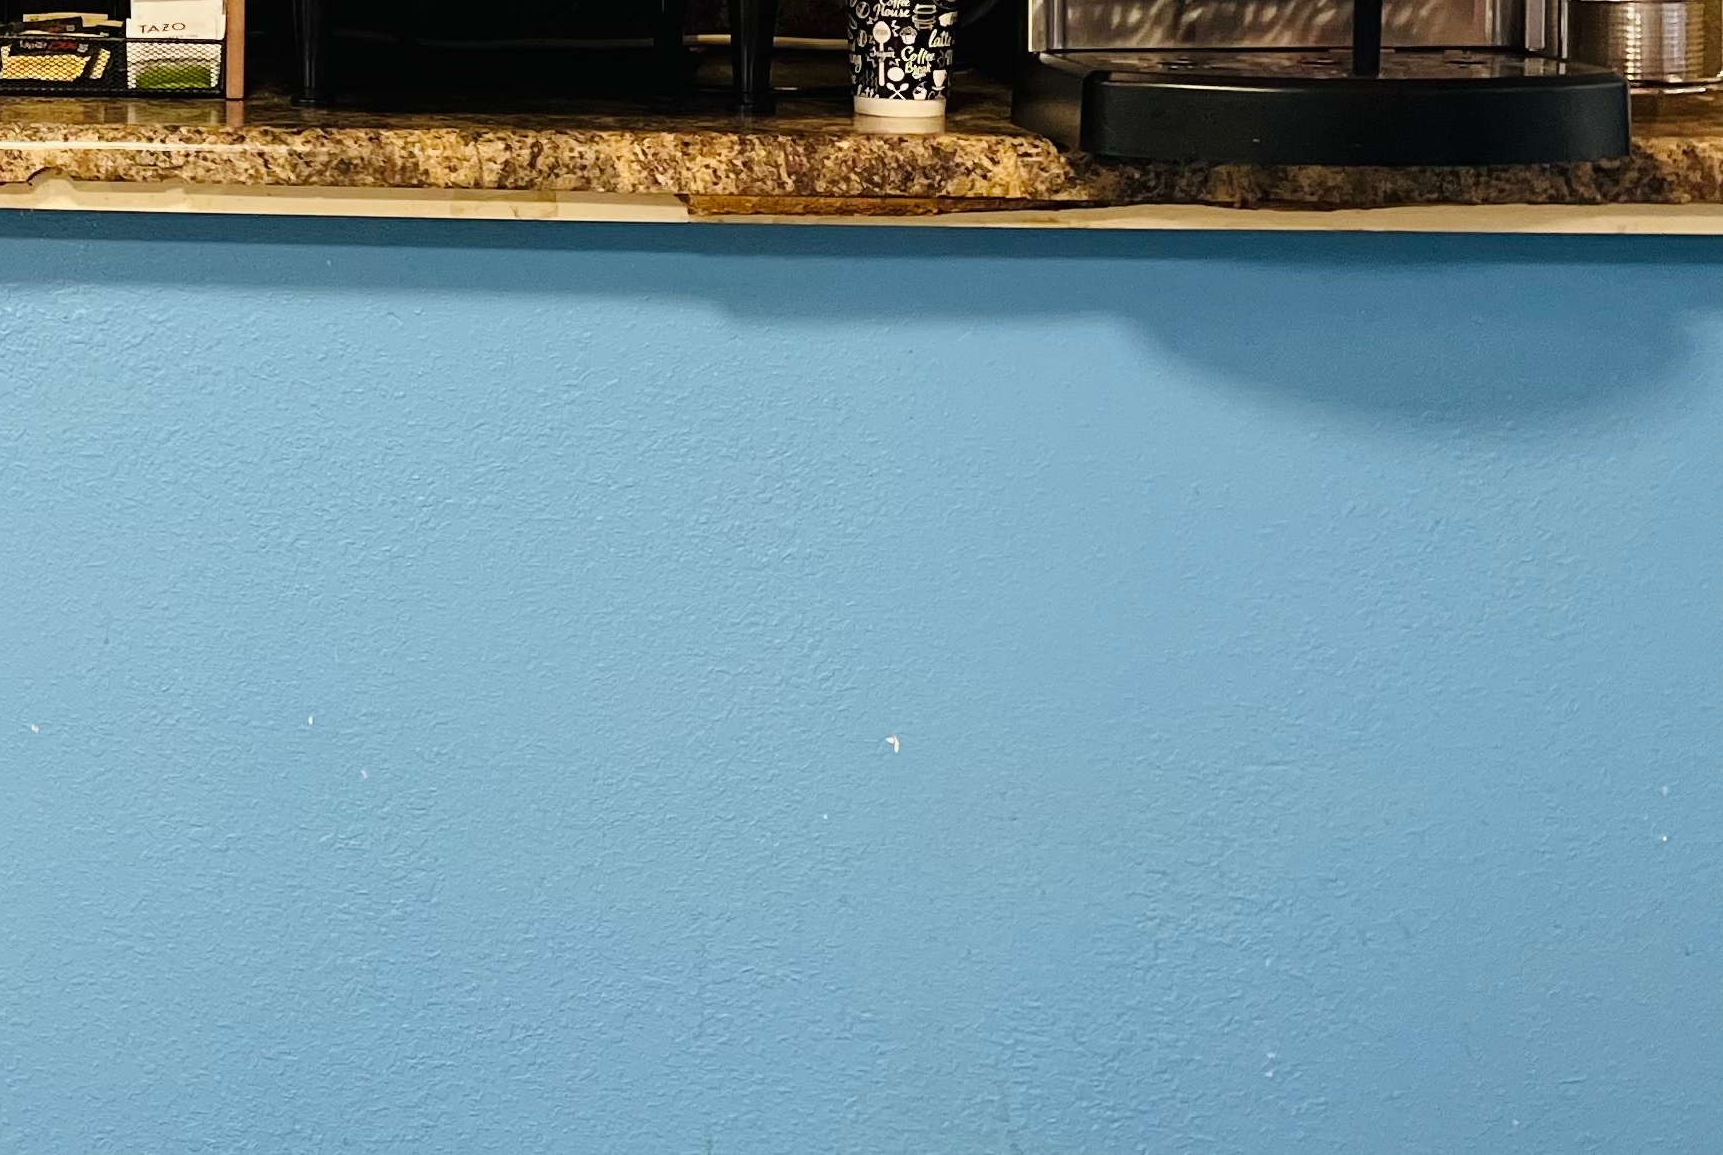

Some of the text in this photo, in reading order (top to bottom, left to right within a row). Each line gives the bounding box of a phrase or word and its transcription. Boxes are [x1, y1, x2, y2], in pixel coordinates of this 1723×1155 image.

[873, 4, 911, 21] House
[139, 22, 186, 34] TAZO
[901, 46, 935, 64] Coffee
[905, 60, 932, 76] Break
